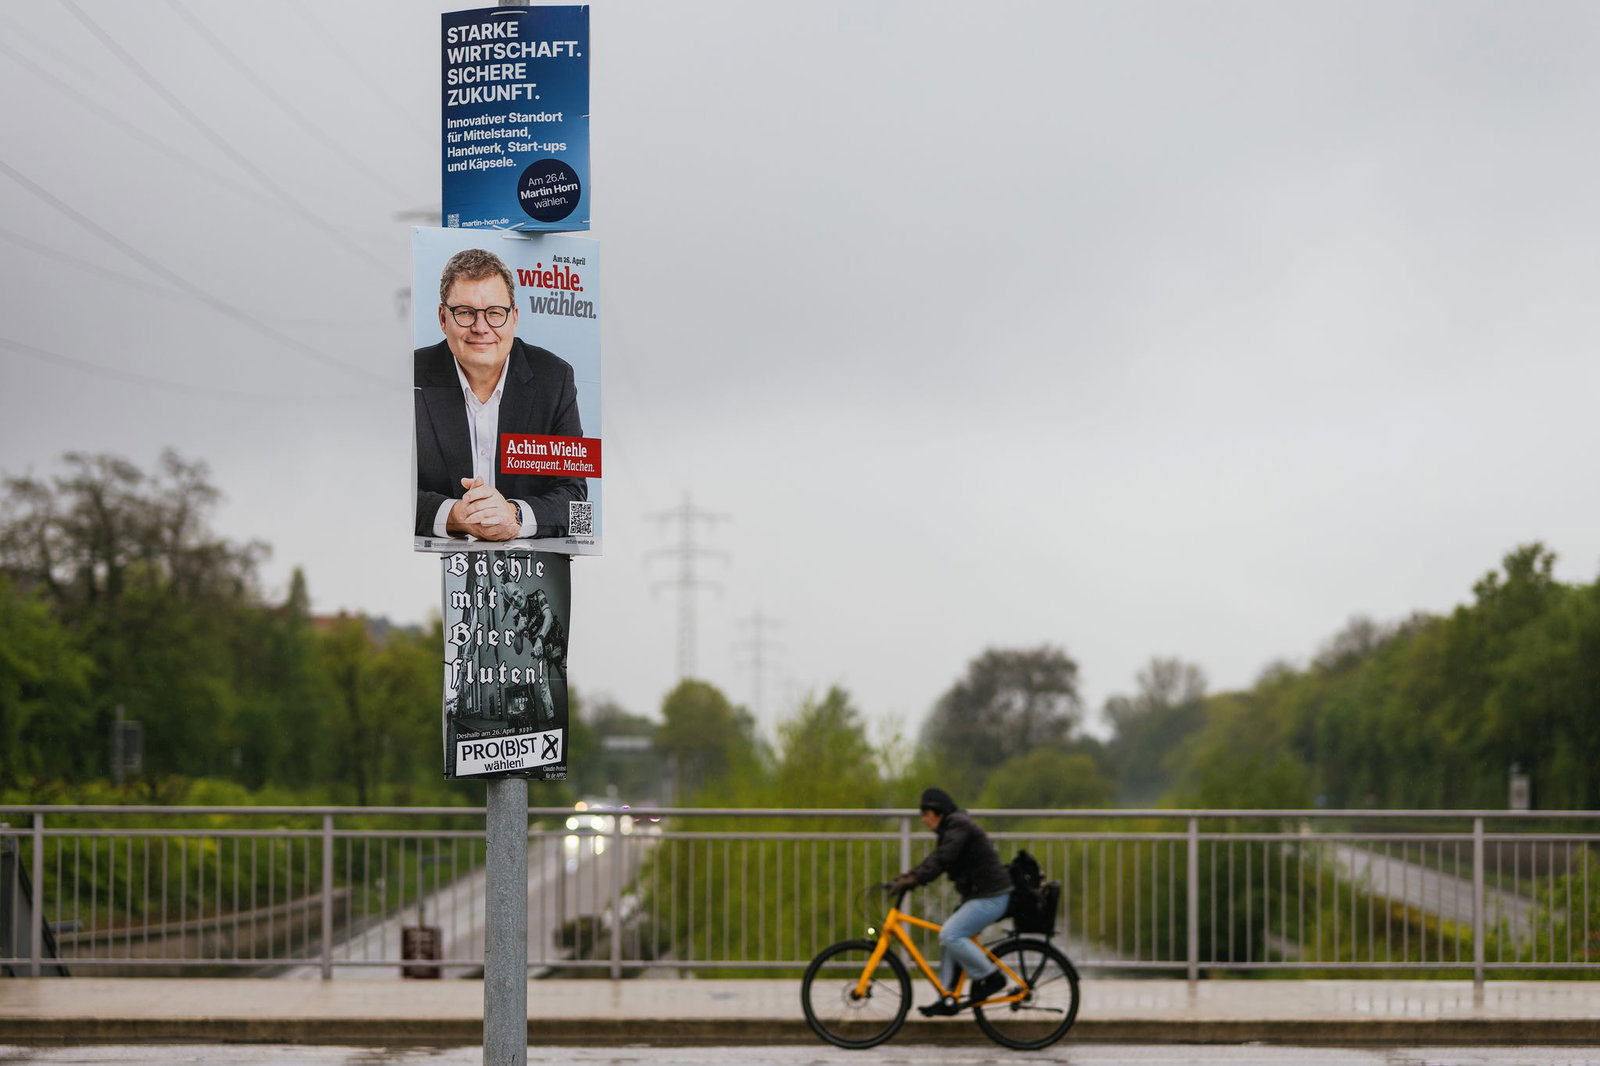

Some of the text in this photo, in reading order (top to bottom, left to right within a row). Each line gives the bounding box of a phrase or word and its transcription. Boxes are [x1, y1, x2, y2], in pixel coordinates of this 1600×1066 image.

[447, 21, 519, 44] STARKE
[447, 40, 582, 65] WIRTSCHAFT.
[447, 62, 527, 86] SICHERE
[447, 83, 541, 107] ZUKUNFT.
[447, 112, 563, 129] Innovativer Standort
[447, 127, 532, 143] für Mittelstand,
[447, 141, 567, 158] Handwerk, Start-ups
[447, 157, 517, 172] und Käpsele.
[528, 172, 568, 187] Am 26.4.
[520, 182, 578, 200] Martin Horn
[534, 196, 569, 209] wählen.
[461, 218, 510, 228] martin-horn.de
[553, 255, 562, 263] Am
[571, 257, 586, 267] April
[517, 262, 583, 292] wiehle.
[529, 291, 597, 319] wählen.
[506, 440, 587, 458] Achim Wiehle
[506, 457, 595, 473] Konsequent. Machen.
[447, 552, 545, 583] Bächle
[451, 586, 498, 609] mit
[448, 621, 516, 647] Bier
[456, 732, 480, 740] Deshalb
[462, 737, 538, 761] PRO(B)ST
[484, 758, 524, 772] wählen!
